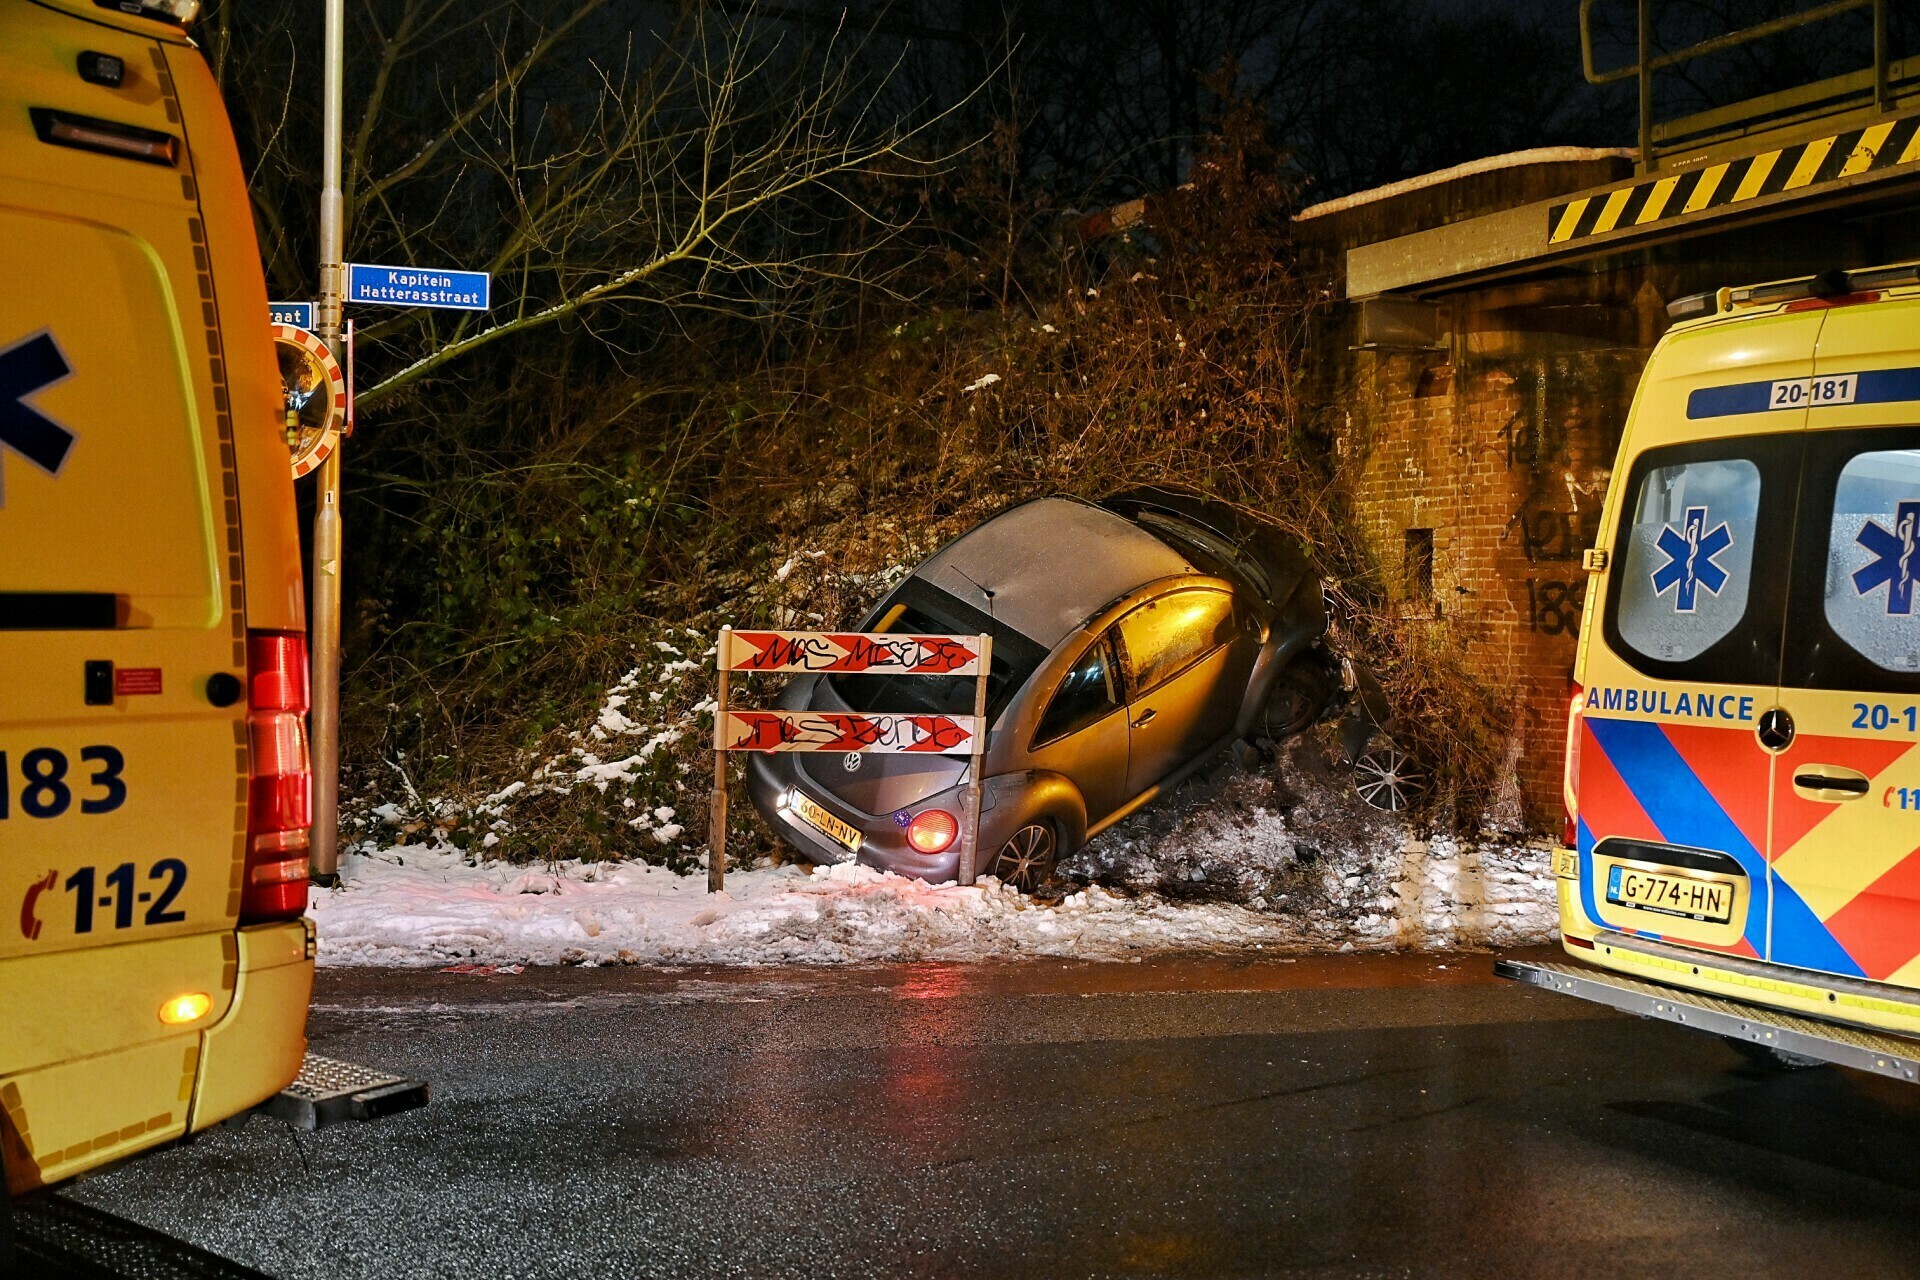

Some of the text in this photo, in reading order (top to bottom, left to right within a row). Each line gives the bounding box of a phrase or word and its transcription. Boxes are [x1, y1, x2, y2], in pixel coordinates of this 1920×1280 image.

[388, 271, 451, 288] Kapitein
[360, 285, 478, 304] Hatterasstraat
[1775, 379, 1849, 404] 20-181
[1585, 687, 1754, 721] AMBULANCE
[800, 800, 858, 844] 60-LN-NV
[65, 858, 187, 934] 1-1-2
[1610, 885, 1619, 895] NL
[1625, 875, 1722, 912] G-774-HN
